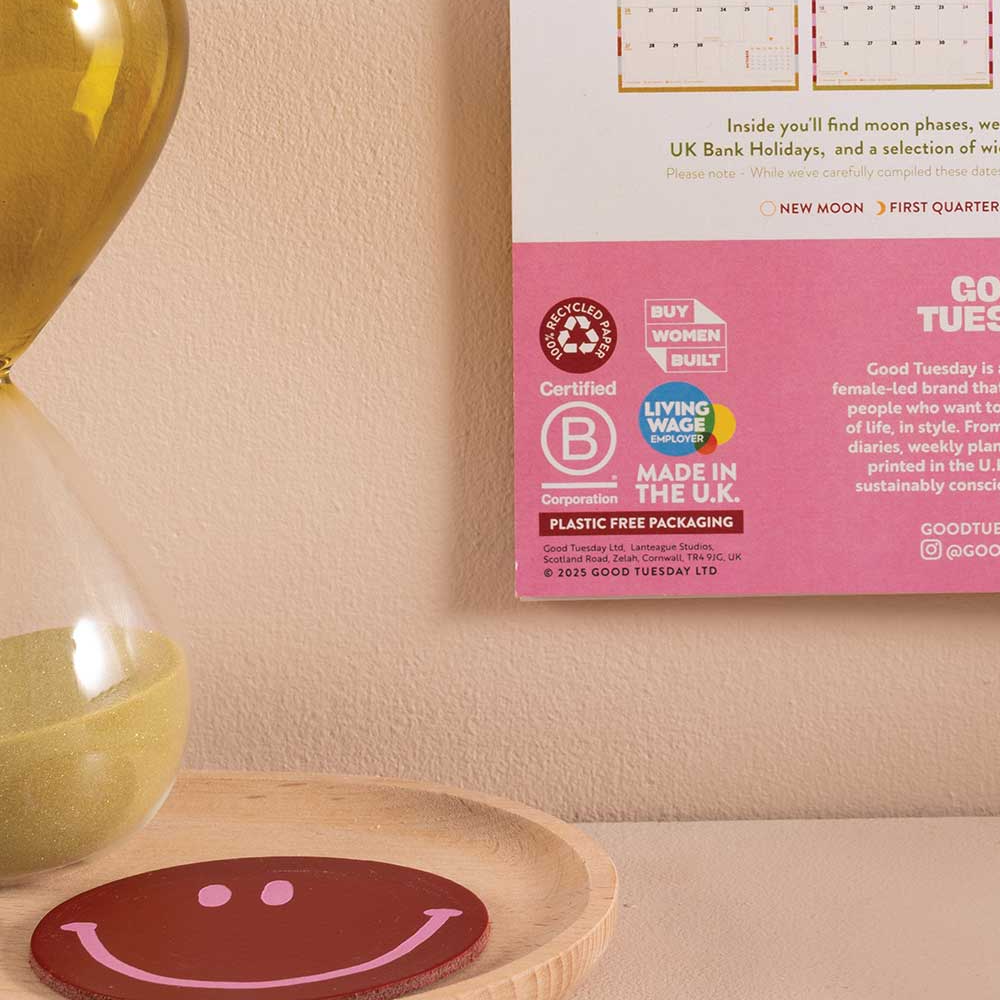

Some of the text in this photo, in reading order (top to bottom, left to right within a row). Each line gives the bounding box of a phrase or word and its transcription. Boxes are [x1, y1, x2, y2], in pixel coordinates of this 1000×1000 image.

[728, 118, 774, 132] Inside
[780, 117, 821, 137] you'll
[828, 117, 858, 131] find
[865, 122, 909, 131] moon
[916, 116, 973, 136] phases,
[671, 142, 696, 157] UK
[704, 142, 744, 156] Bank
[750, 142, 824, 161] Holidays,
[835, 140, 863, 155] and
[870, 146, 876, 155] a
[883, 140, 954, 155] selection
[960, 139, 976, 154] of
[780, 203, 863, 214] NEW MOON
[890, 201, 999, 215] FIRST QUARTER
[650, 305, 689, 318] BUY
[544, 302, 612, 360] 100% RECYCLED PAPER
[652, 329, 721, 342] WOMEN
[672, 354, 720, 366] BUILT
[867, 362, 909, 375] Good
[913, 362, 977, 378] Tuesday
[982, 362, 994, 374] is
[540, 381, 616, 396] Certified
[832, 382, 917, 395] female-led
[922, 381, 968, 394] brand
[644, 401, 710, 416] LIVING
[647, 417, 706, 433] WAGE
[562, 416, 598, 461] B
[650, 434, 704, 444] EMPLOYER
[848, 440, 903, 455] diaries,
[908, 440, 963, 456] weekly
[637, 463, 736, 482] MADE IN
[635, 483, 740, 503] THE U.K.
[856, 479, 945, 495] sustainably
[542, 493, 618, 506] Corporation
[550, 516, 733, 530] PLASTIC FREE PACKAGING
[558, 568, 586, 577] 2025
[592, 568, 629, 576] GOOD
[634, 567, 690, 576] TUESDAY
[696, 566, 717, 575] LTD
